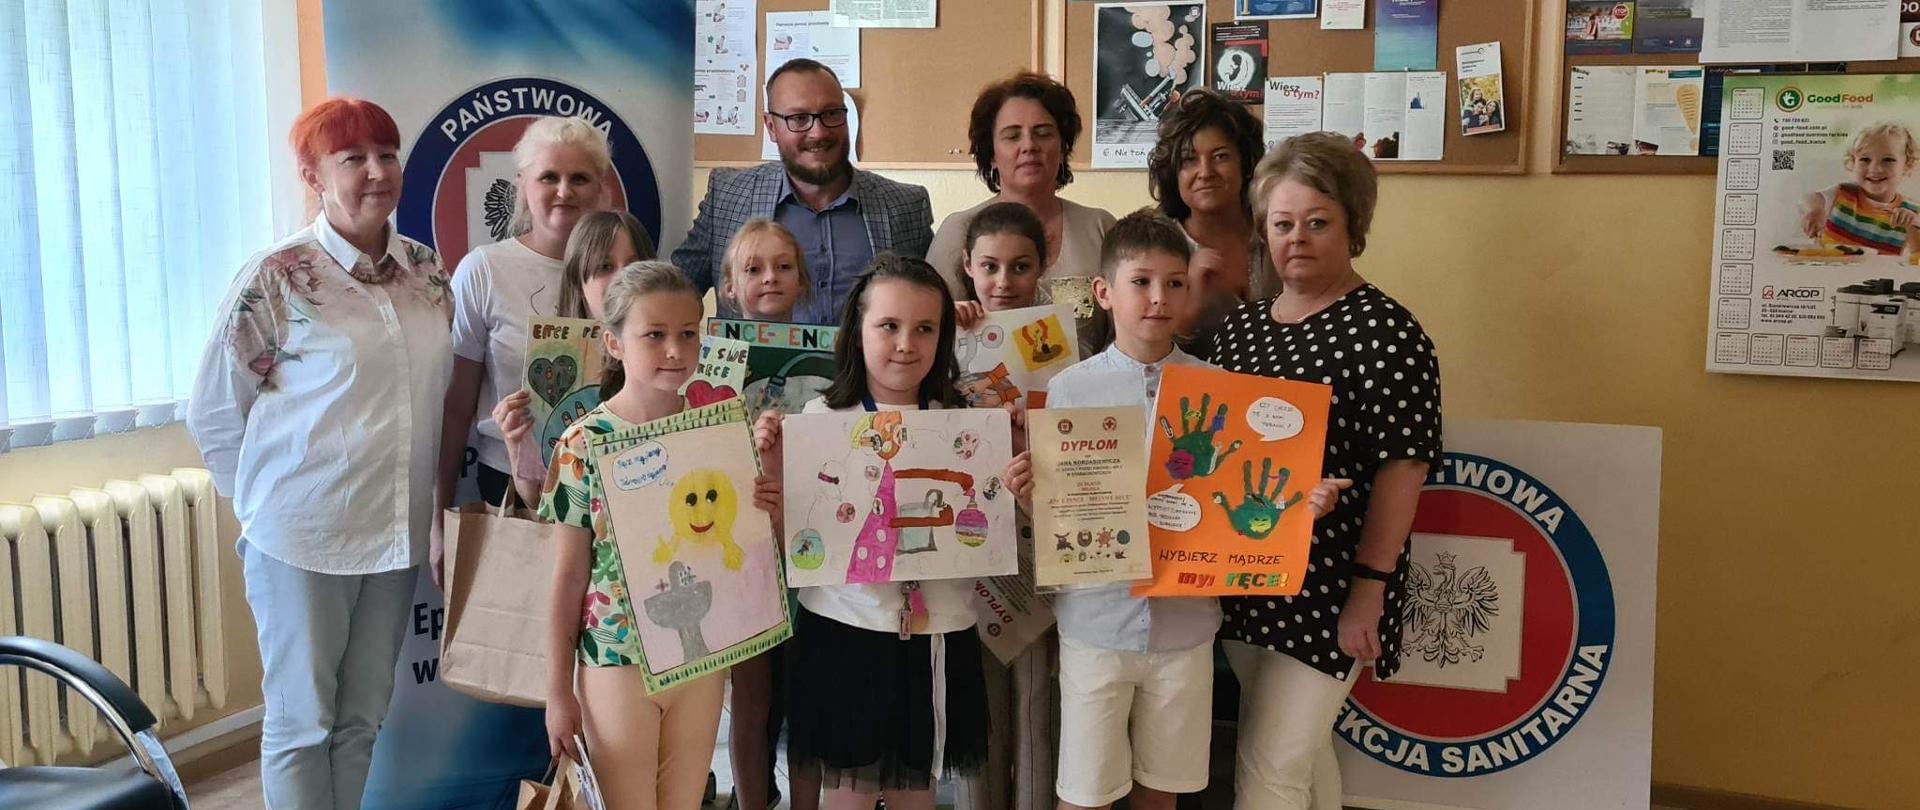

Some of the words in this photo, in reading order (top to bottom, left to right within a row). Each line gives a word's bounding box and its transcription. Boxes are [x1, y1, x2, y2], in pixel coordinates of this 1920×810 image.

[1269, 81, 1300, 92] Wiesz
[1283, 89, 1291, 97] o
[1293, 88, 1320, 100] tym?
[1807, 94, 1874, 104] GoodFood
[441, 87, 612, 142] PAŃSTWOWA
[1777, 289, 1820, 298] ARCOP
[1061, 439, 1118, 452] DYPLOM
[1160, 549, 1218, 563] WYBIERZ
[1228, 553, 1285, 566] MĄDRZE
[1441, 644, 1608, 773] SANITARNA
